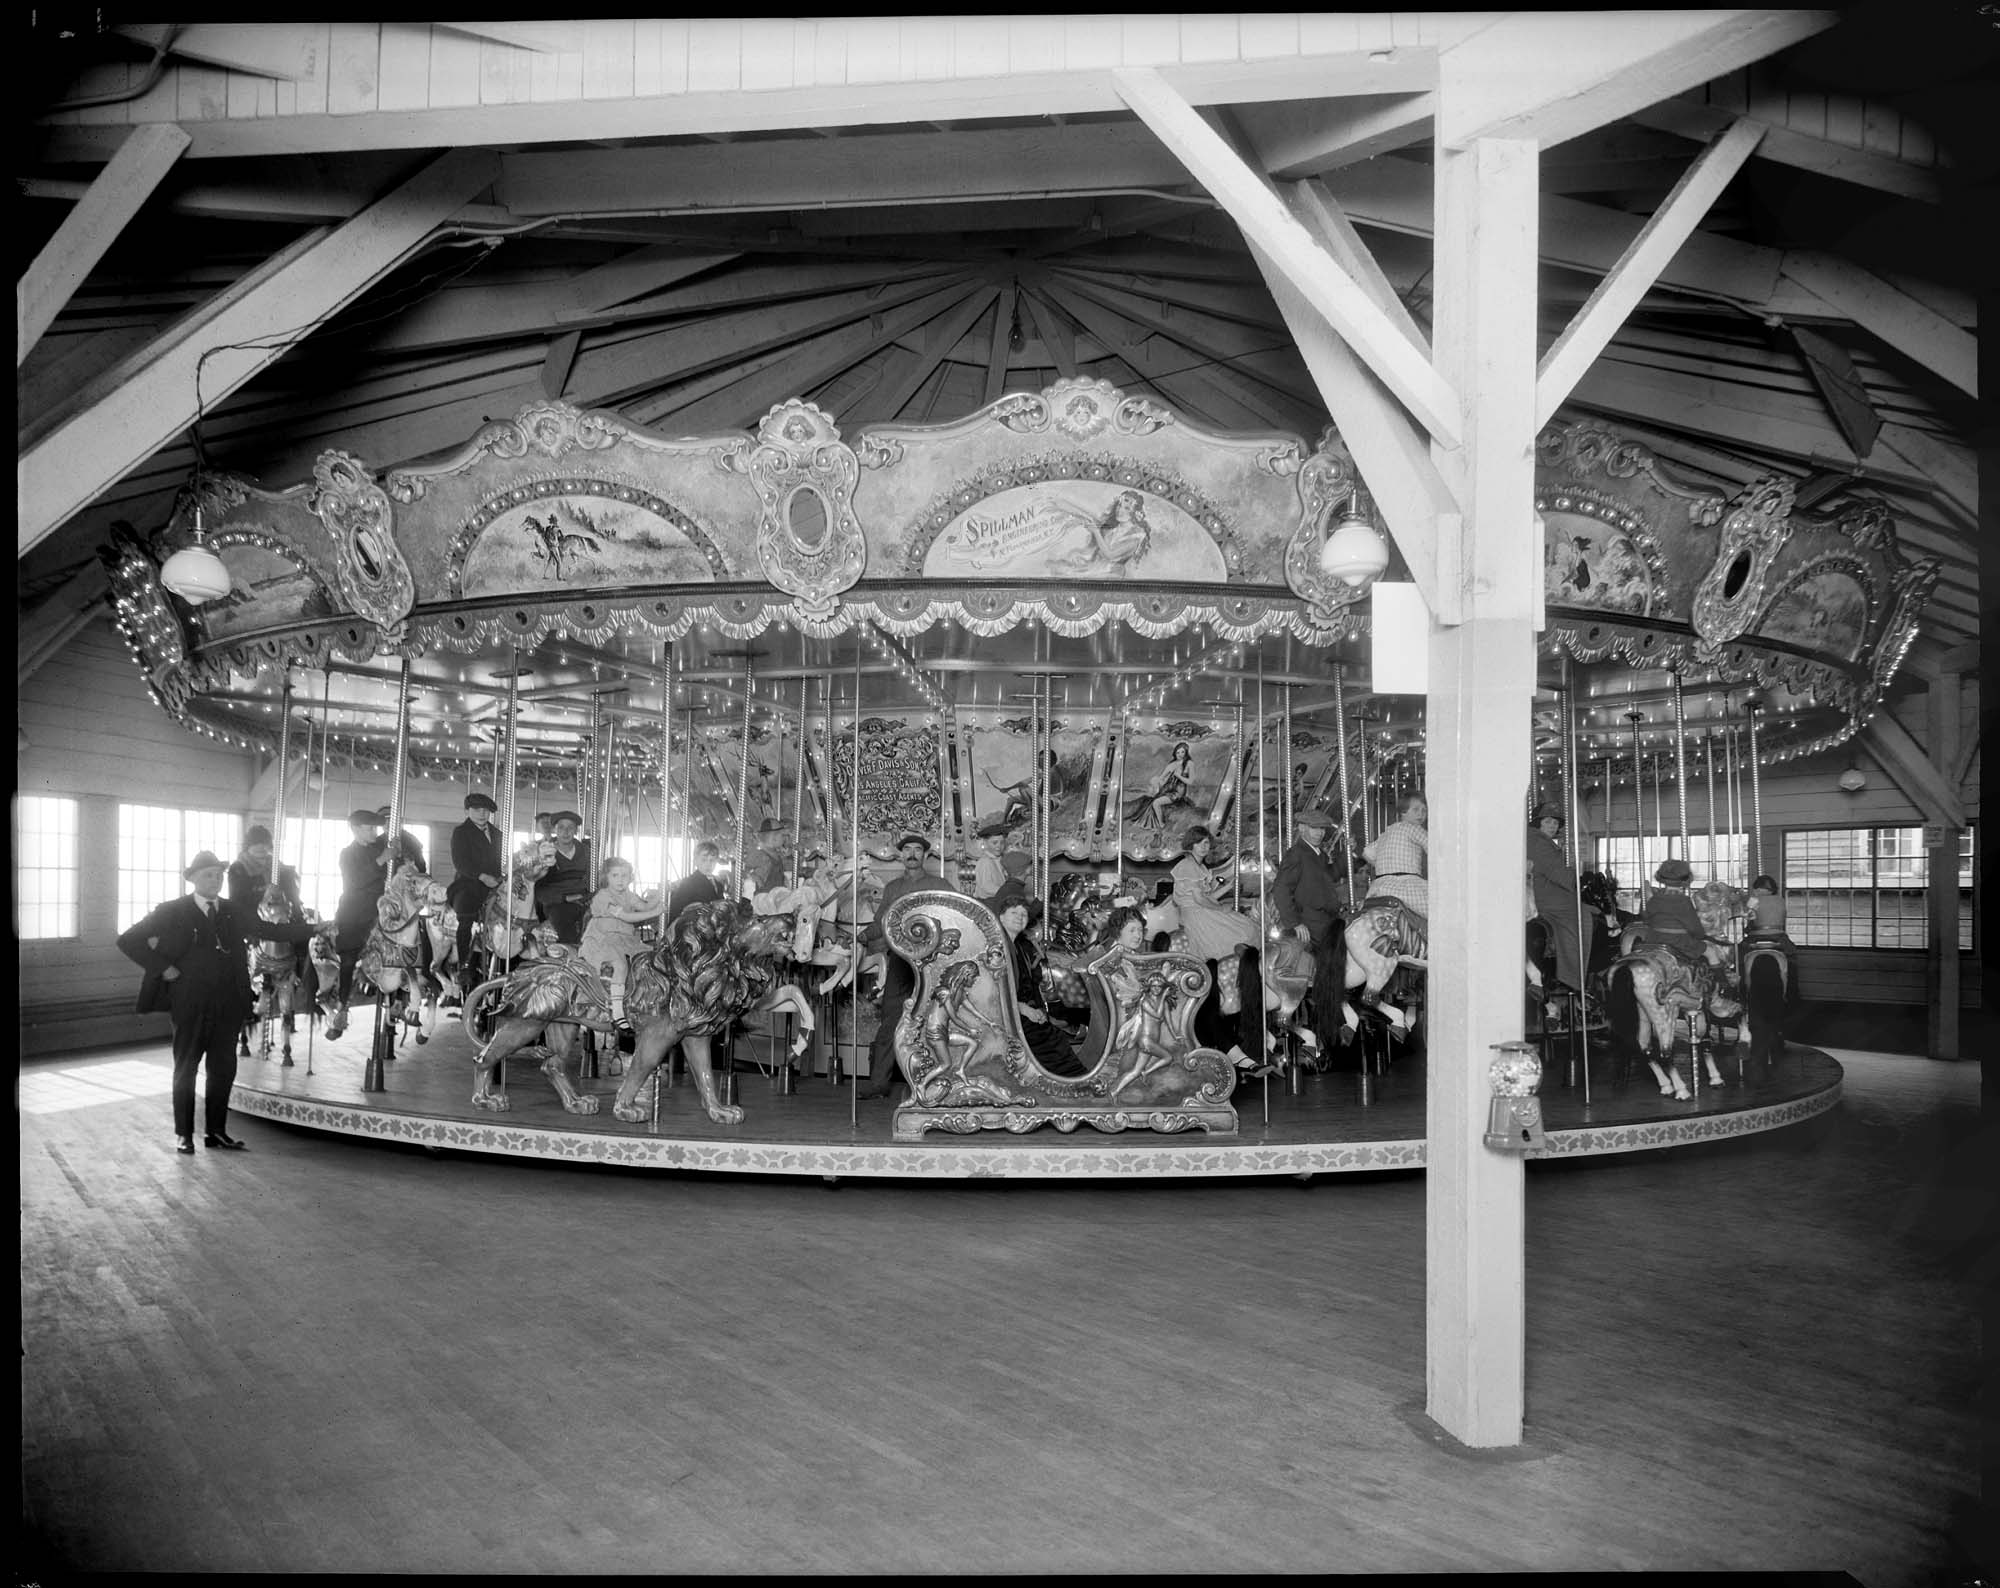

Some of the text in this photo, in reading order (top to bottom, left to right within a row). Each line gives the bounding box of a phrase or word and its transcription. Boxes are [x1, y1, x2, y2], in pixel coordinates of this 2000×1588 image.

[966, 505, 1034, 546] SPILLMAN
[878, 760, 900, 770] DAVIS
[905, 757, 920, 771] SON
[865, 780, 897, 789] ANGELES
[879, 792, 897, 802] COAST
[898, 793, 922, 801] AGENTS
